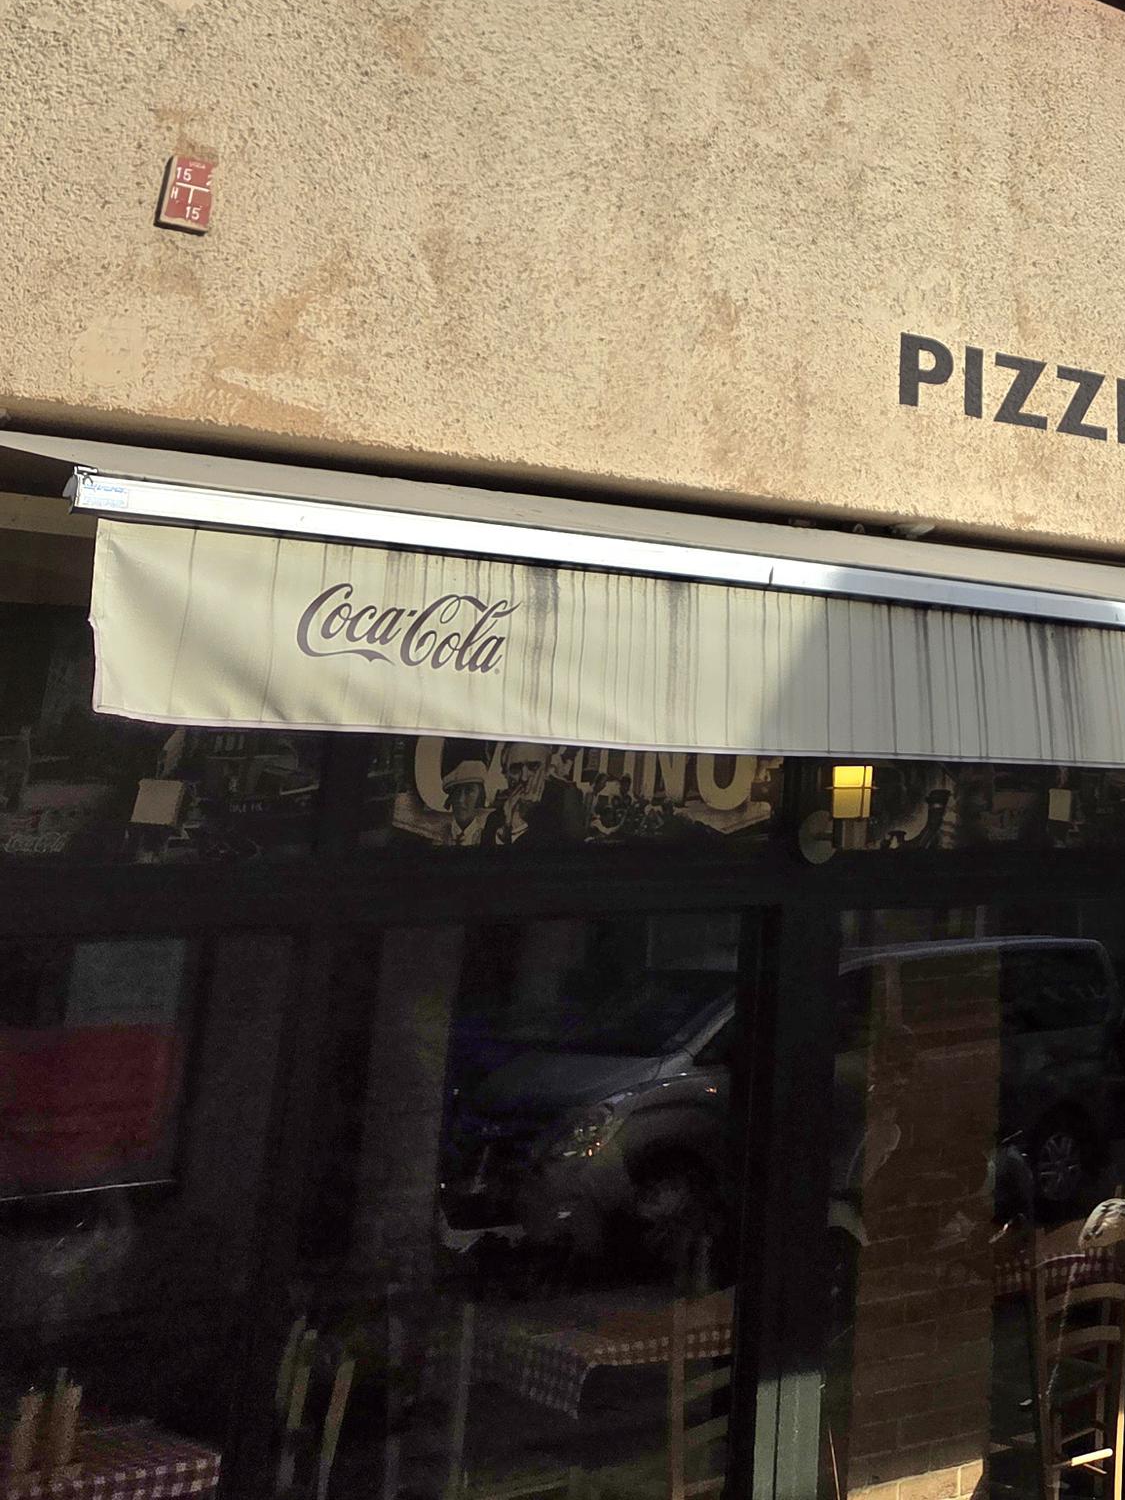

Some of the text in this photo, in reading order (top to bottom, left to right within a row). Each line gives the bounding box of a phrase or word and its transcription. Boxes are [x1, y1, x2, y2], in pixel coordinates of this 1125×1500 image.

[176, 166, 193, 182] 15
[170, 186, 179, 200] H
[185, 206, 202, 221] 15
[297, 583, 521, 673] Coca-Cola
